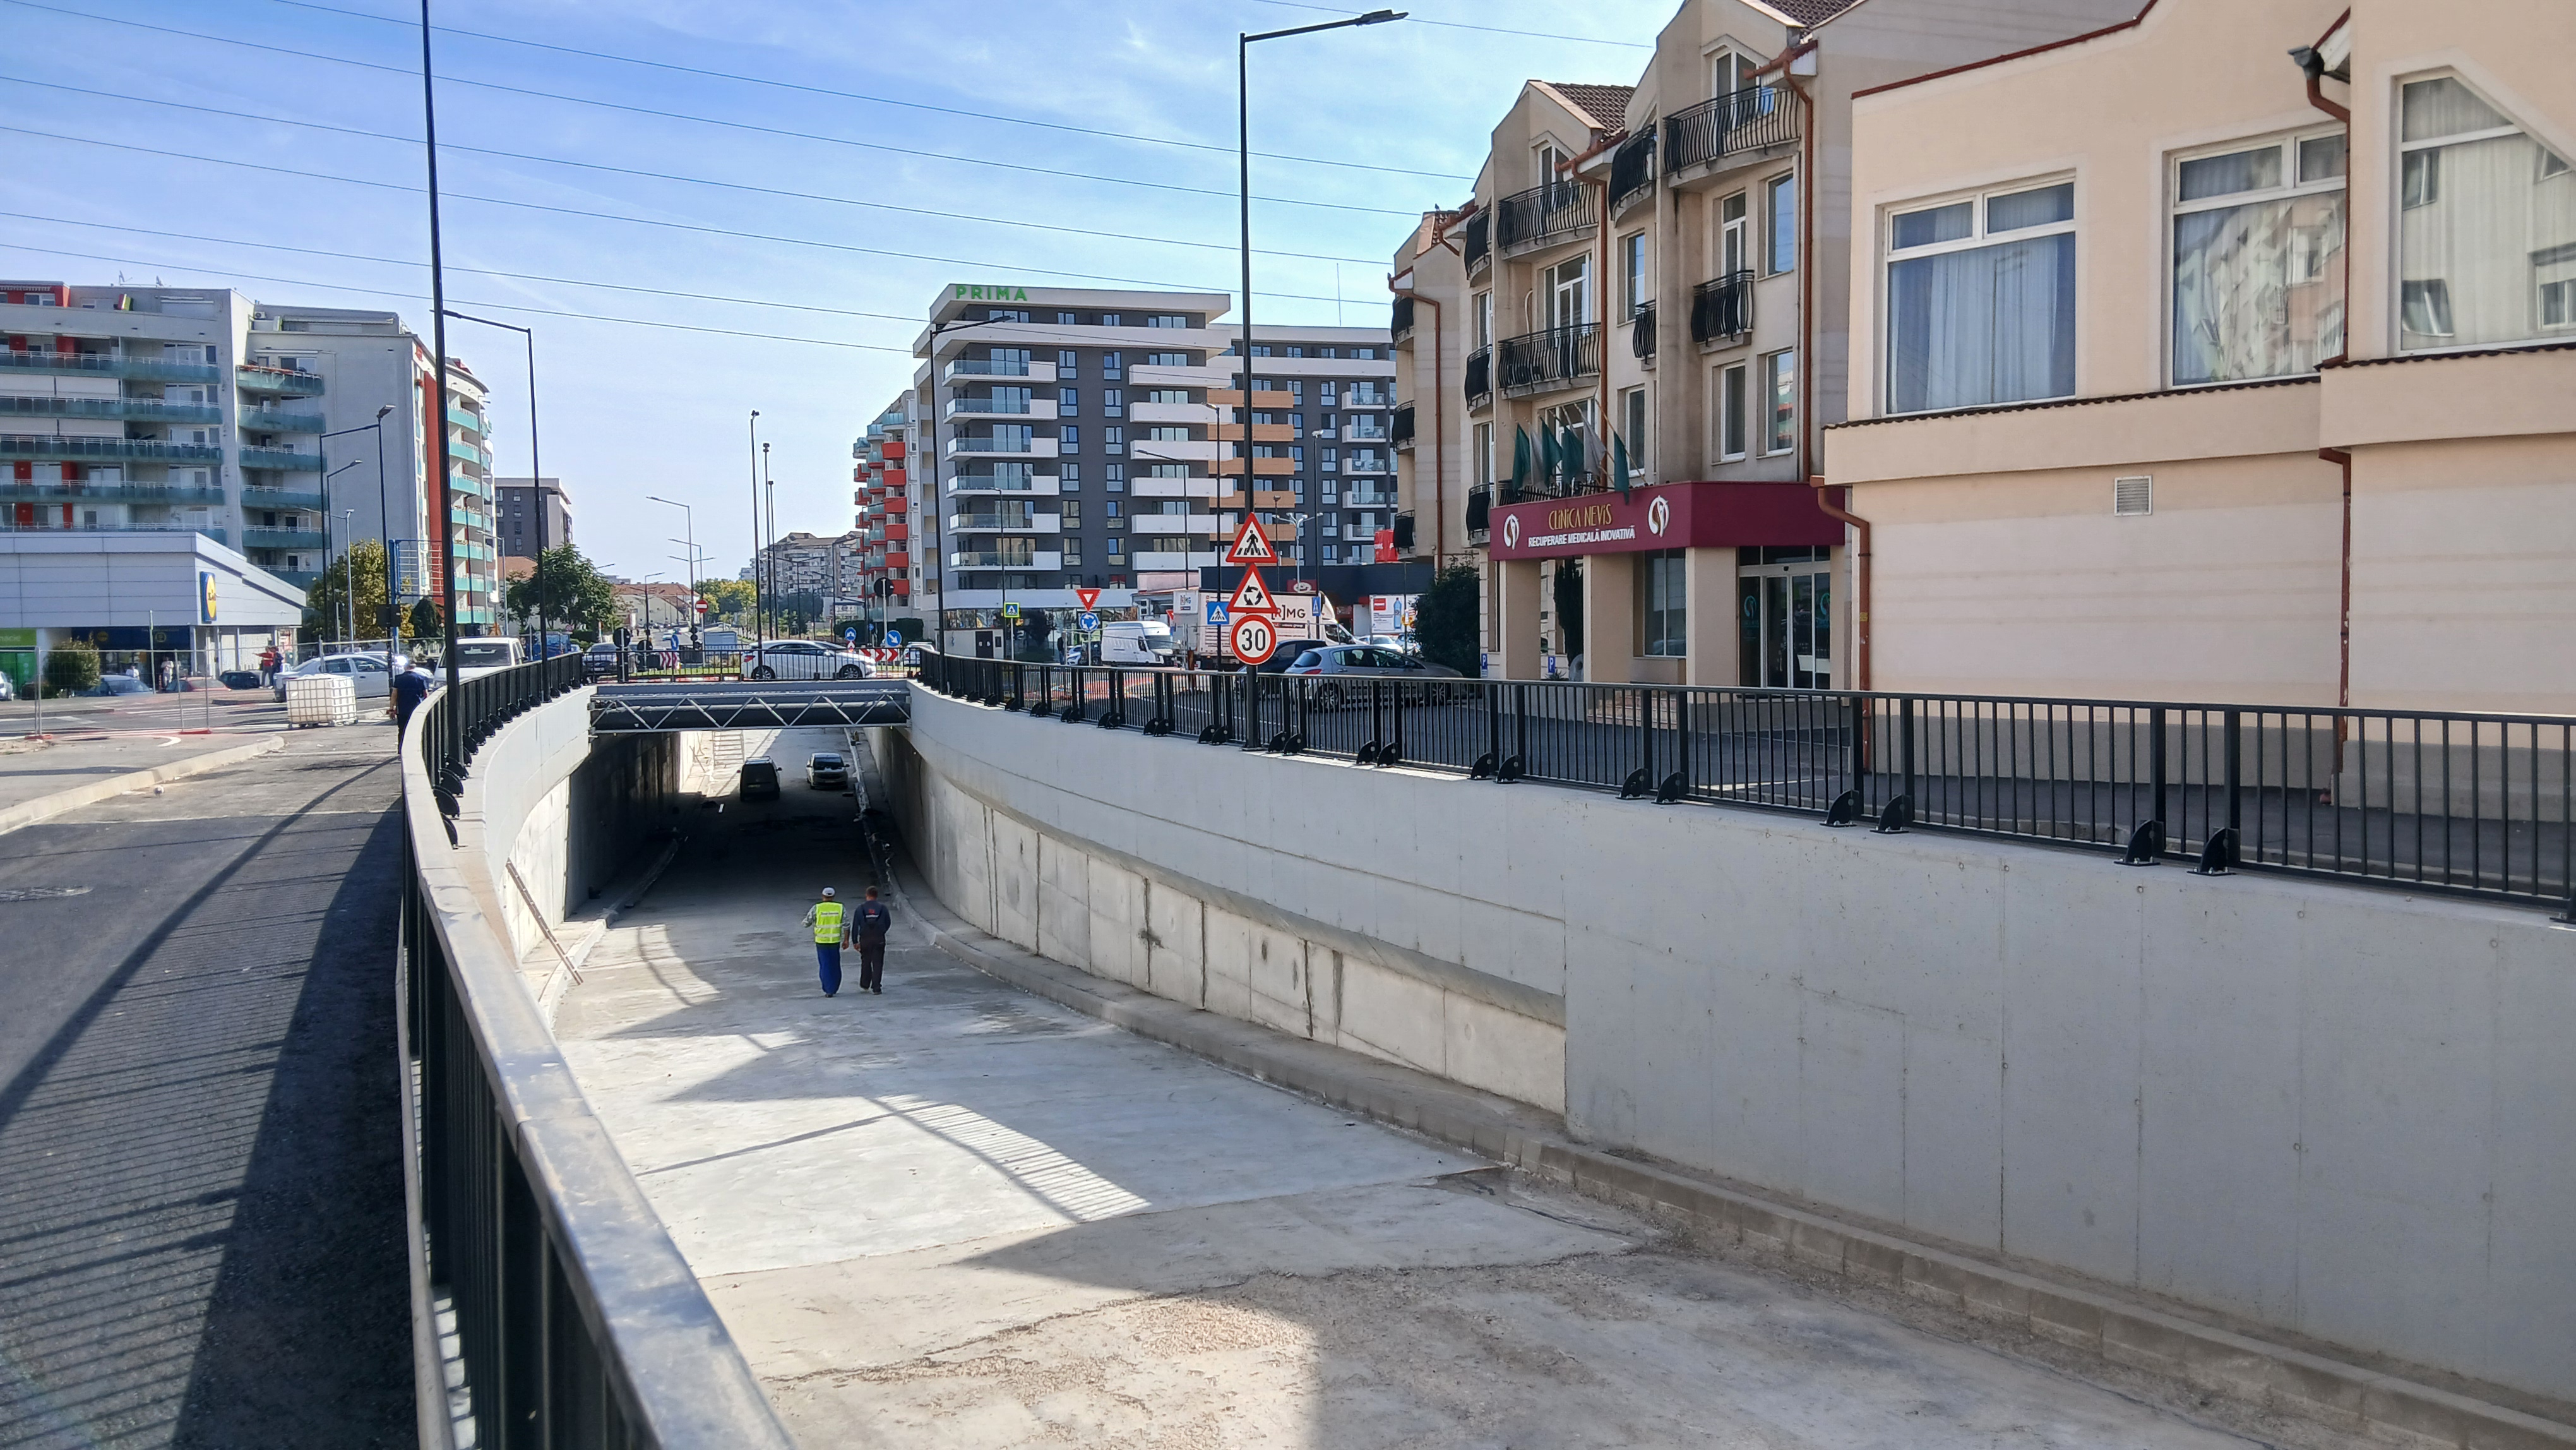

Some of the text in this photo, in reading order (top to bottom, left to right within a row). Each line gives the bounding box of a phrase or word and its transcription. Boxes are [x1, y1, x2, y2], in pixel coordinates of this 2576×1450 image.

[956, 285, 1027, 301] PRIMA
[1528, 534, 1567, 548] RECUPERARE
[1568, 528, 1600, 544] MEDICALĂ
[1241, 628, 1266, 651] 30
[1482, 655, 1486, 666] P
[1549, 657, 1554, 671] P
